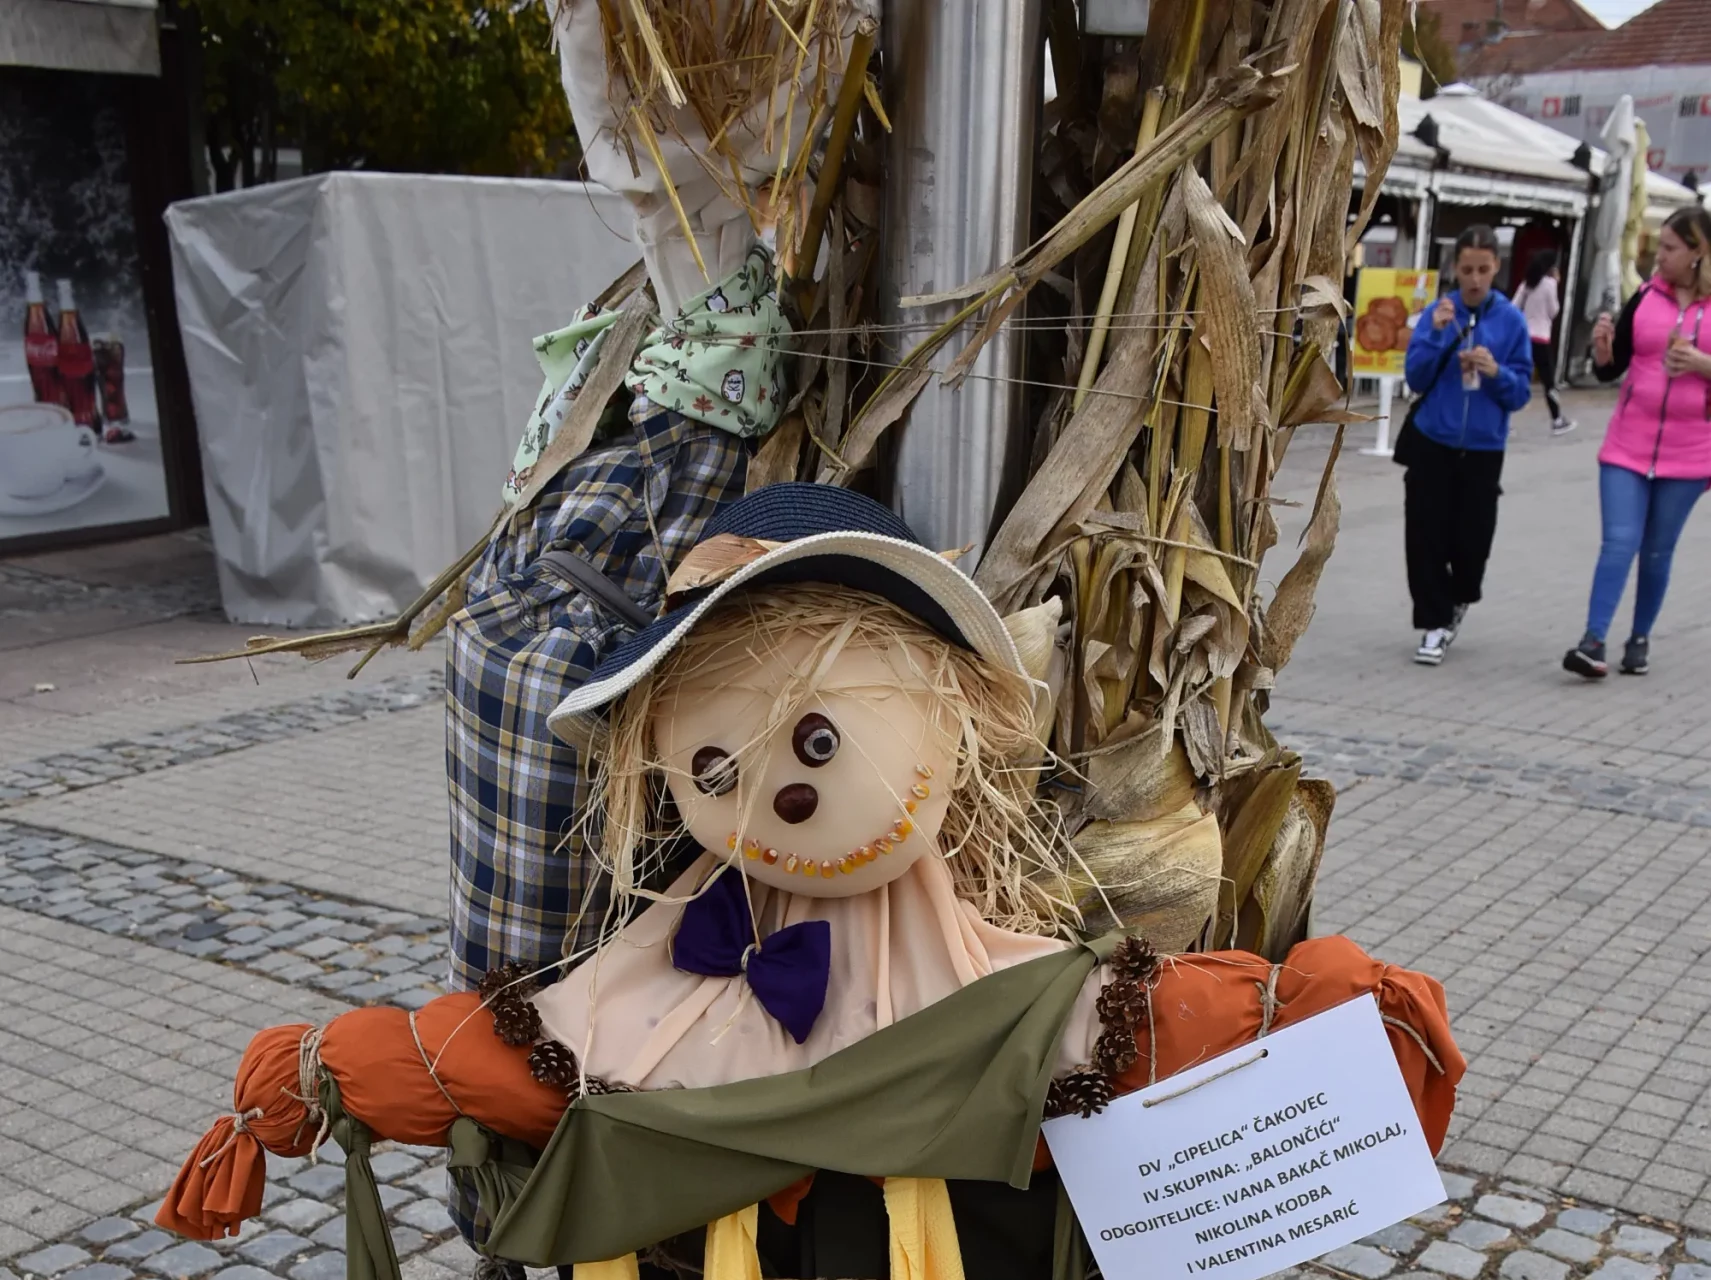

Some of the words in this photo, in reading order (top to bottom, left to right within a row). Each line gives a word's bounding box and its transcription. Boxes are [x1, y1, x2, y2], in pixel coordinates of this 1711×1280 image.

[1138, 1159, 1162, 1177] DV
[1253, 1092, 1328, 1133] ČAKOVEC
[1100, 1199, 1220, 1242] ODGOJITELJICE:
[1222, 1177, 1275, 1207] IVANA
[1277, 1150, 1331, 1185] BAKAČ
[1332, 1122, 1407, 1162] MIKOLAJ,
[1143, 1162, 1241, 1204] IV.SKUPINA:
[1194, 1208, 1273, 1244] NIKOLINA
[1274, 1184, 1332, 1216] KODBA
[1186, 1262, 1194, 1274] I
[1195, 1233, 1286, 1271] VALENTINA
[1288, 1200, 1360, 1241] MESARIĆ
